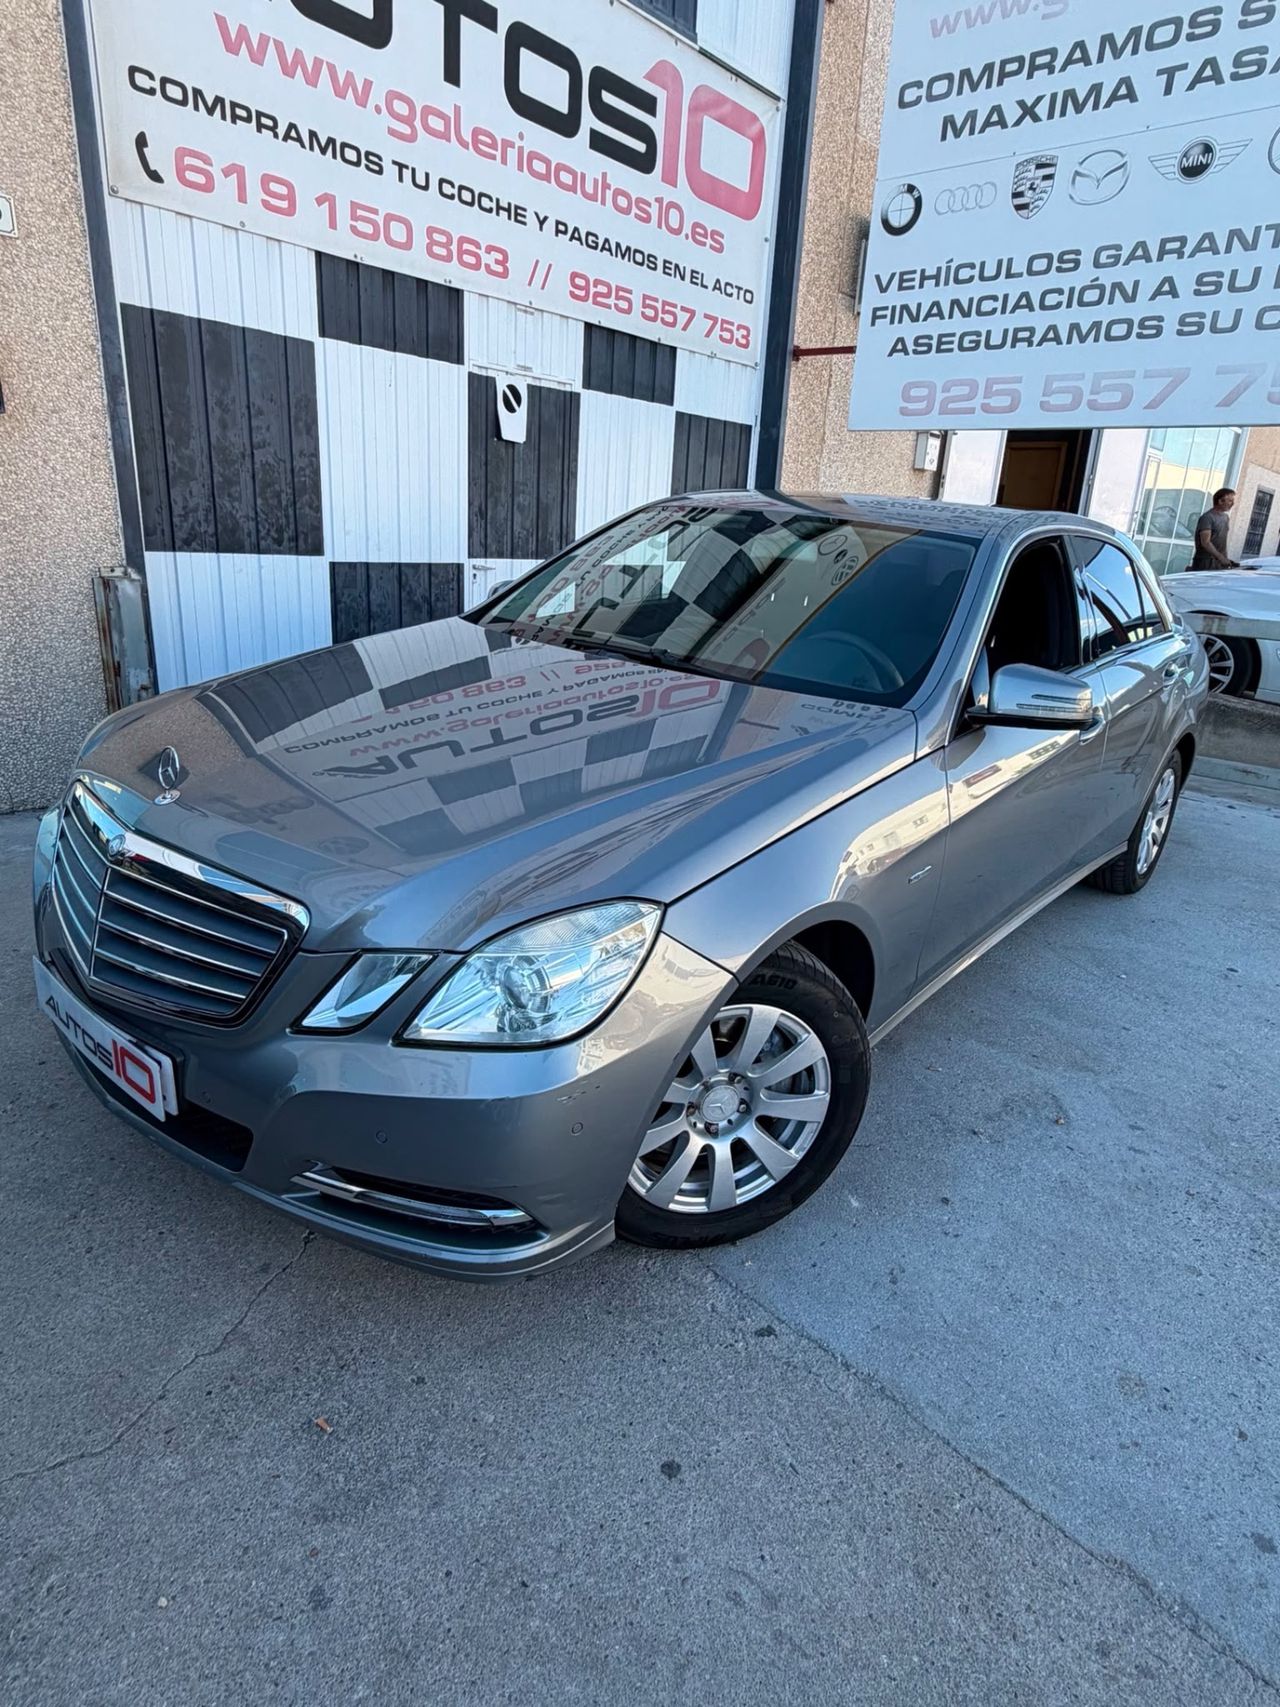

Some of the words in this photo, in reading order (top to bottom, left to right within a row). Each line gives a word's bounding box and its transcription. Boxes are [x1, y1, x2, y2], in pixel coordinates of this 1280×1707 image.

[898, 5, 1223, 109] COMPRAMOS
[214, 12, 724, 254] www.galeriaautos10.es
[940, 76, 1139, 142] MAXIMA
[128, 65, 384, 176] COMPRAMOS
[392, 160, 430, 191] TU
[438, 177, 528, 227] COCHE
[534, 211, 549, 232] Y
[555, 219, 658, 272] PAGAMOS
[662, 258, 686, 282] EN
[690, 268, 708, 290] EL
[712, 278, 754, 305] ACTO
[1181, 152, 1212, 168] MINI
[174, 146, 297, 218] 619
[315, 192, 413, 251] 150
[426, 225, 509, 280] 863
[527, 259, 552, 290] //
[569, 271, 633, 315] 925
[641, 293, 696, 332] 557
[703, 313, 751, 349] 753
[874, 249, 1082, 294] VEHÍCULOS
[870, 276, 1140, 327] FINANCIACIÓN
[1148, 276, 1180, 301] A
[1193, 266, 1262, 297] SU
[887, 315, 1165, 357] ASEGURAMOS
[1176, 308, 1243, 336] SU
[899, 376, 1023, 417] 925
[1039, 367, 1191, 412] 557
[45, 995, 156, 1105] AUTOS10
